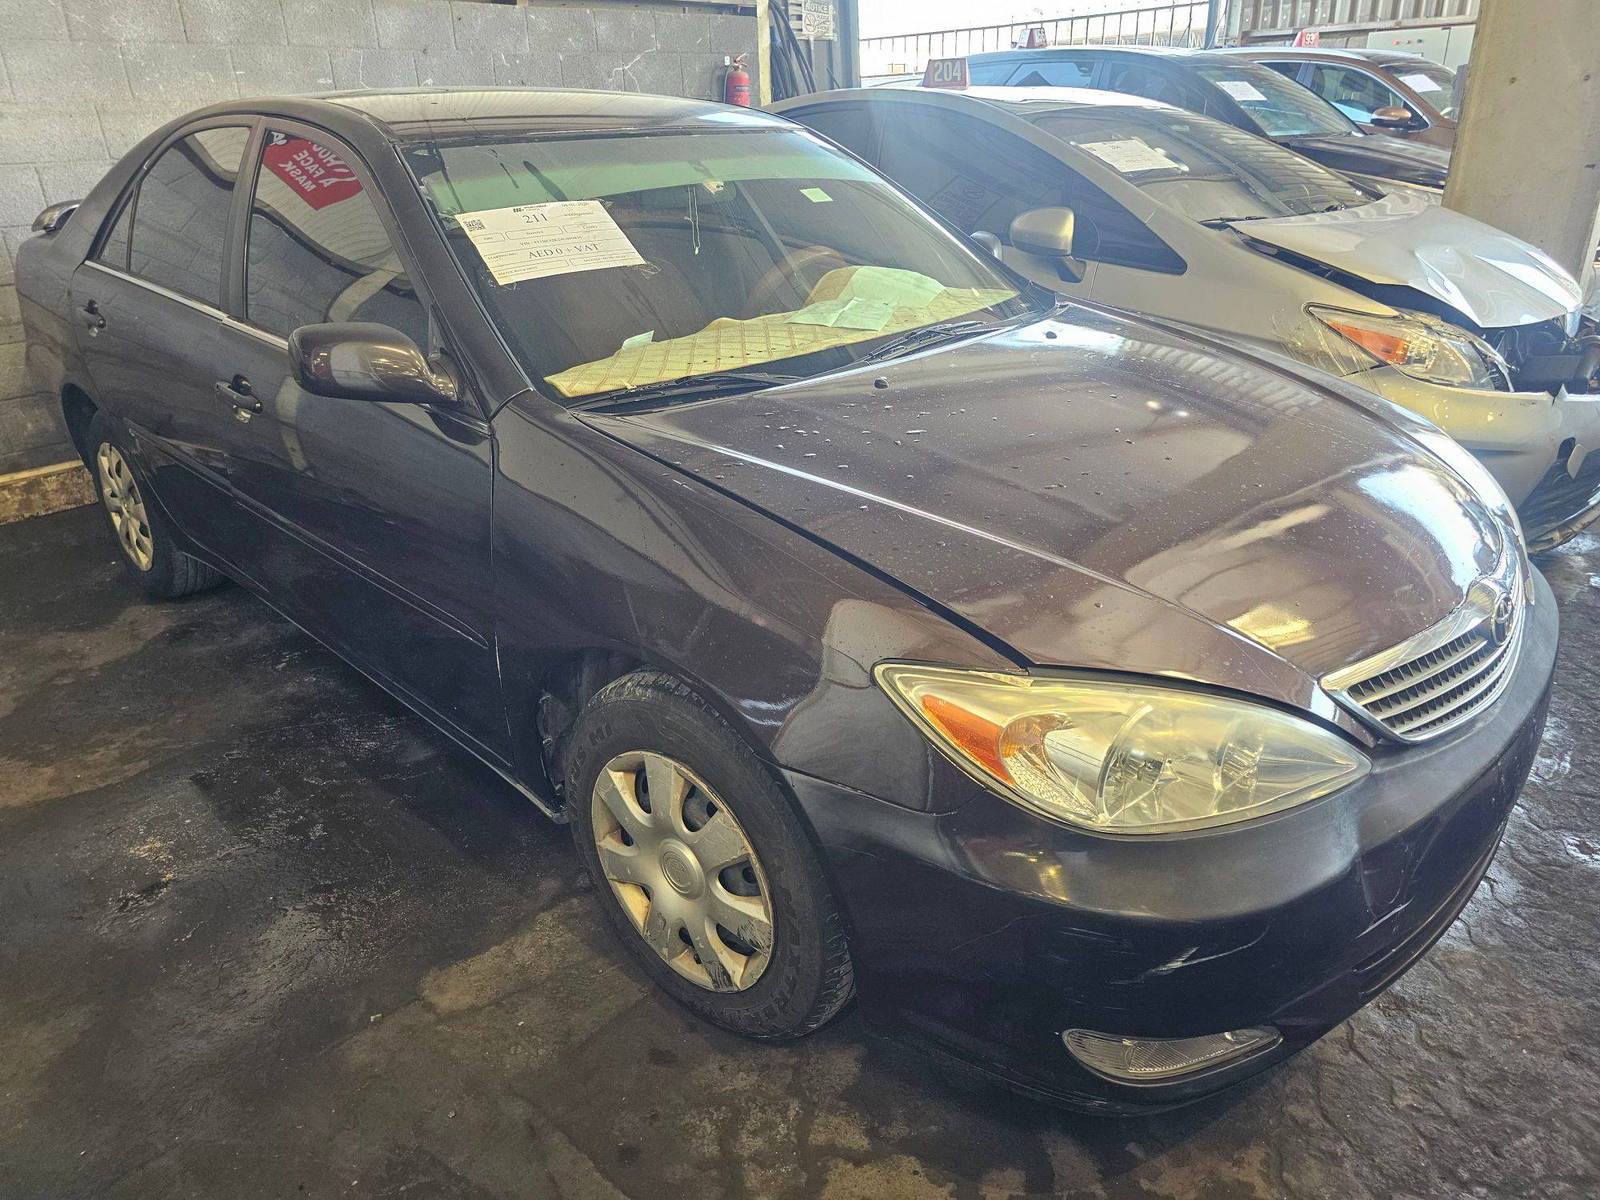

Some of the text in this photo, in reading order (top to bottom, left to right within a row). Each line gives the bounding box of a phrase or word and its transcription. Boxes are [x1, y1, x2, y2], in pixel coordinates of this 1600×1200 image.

[933, 61, 961, 81] 204
[522, 213, 548, 224] 211
[529, 249, 554, 259] AED
[574, 243, 600, 253] VAT
